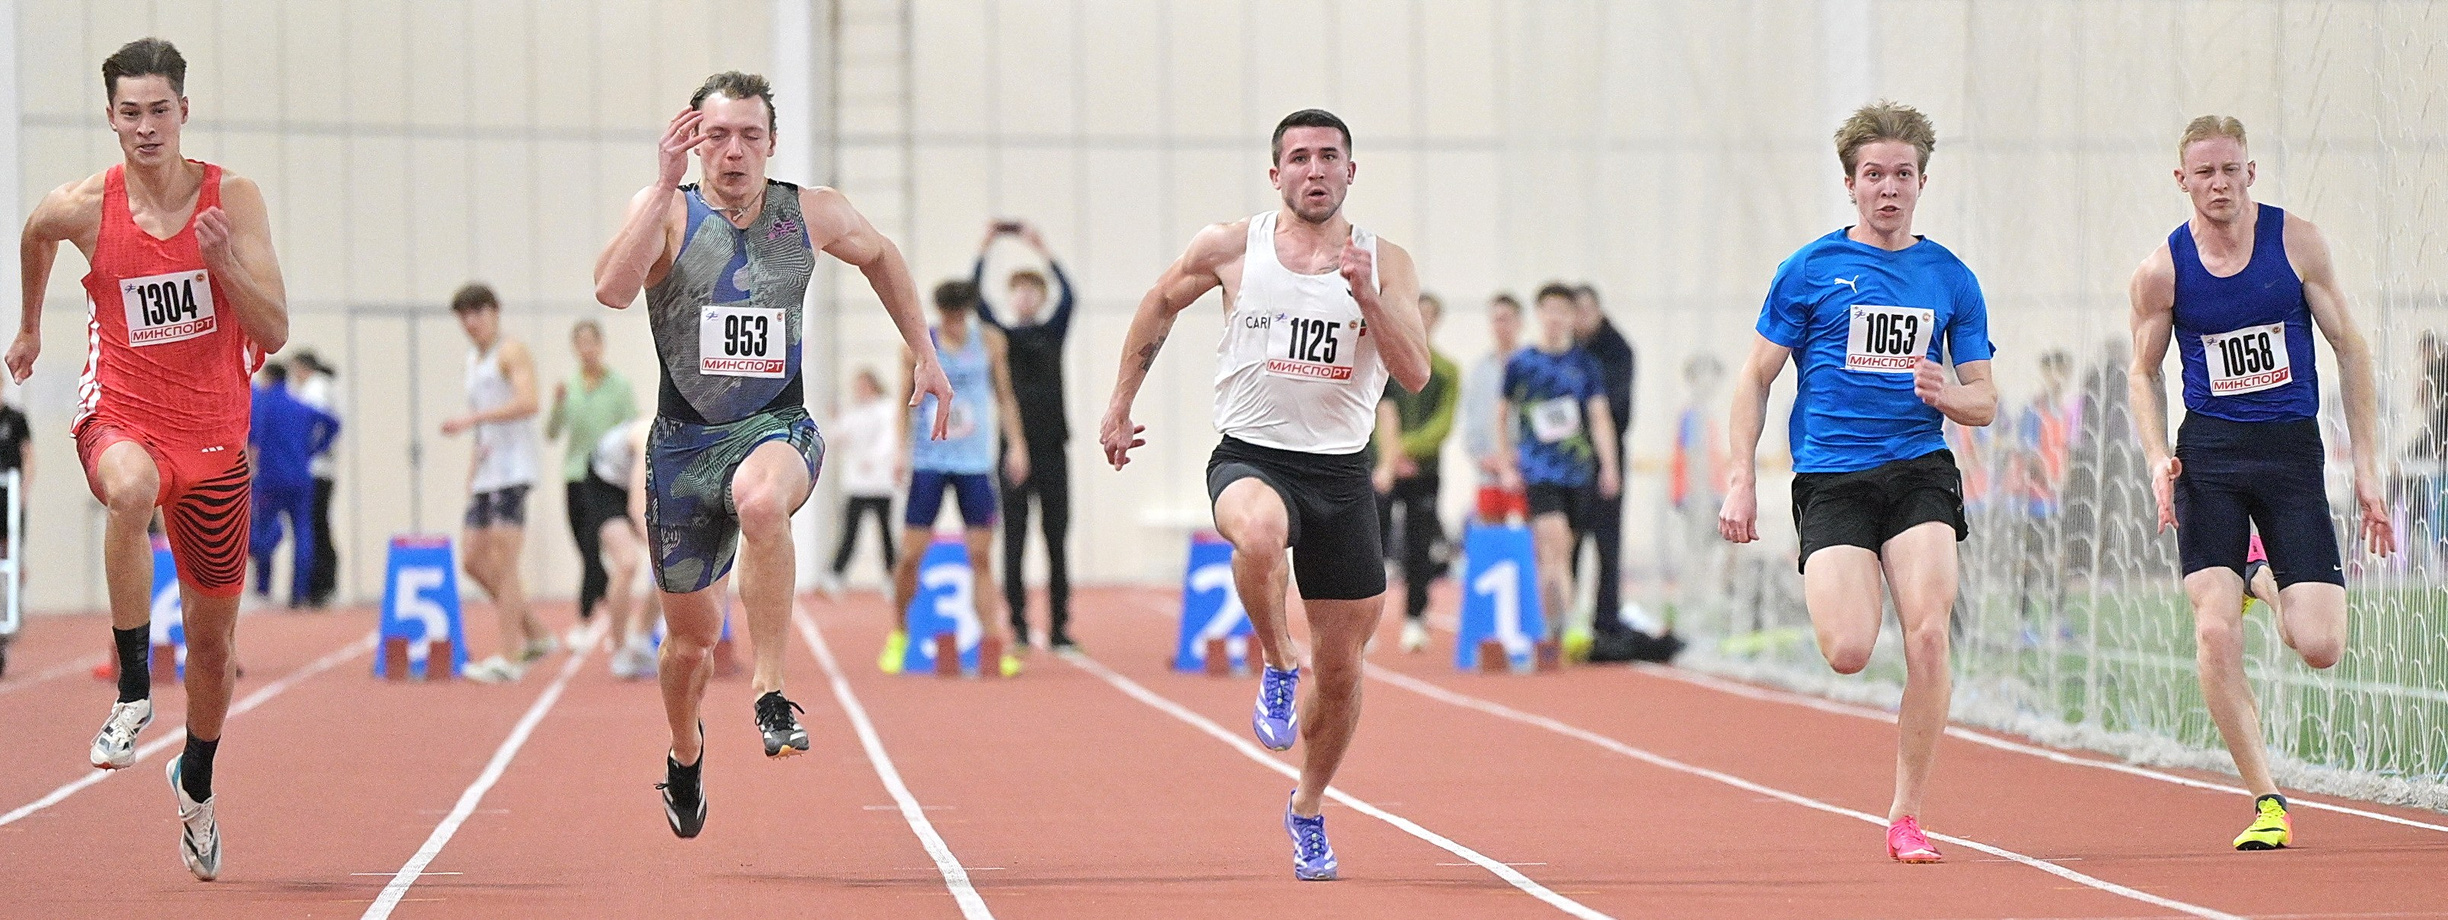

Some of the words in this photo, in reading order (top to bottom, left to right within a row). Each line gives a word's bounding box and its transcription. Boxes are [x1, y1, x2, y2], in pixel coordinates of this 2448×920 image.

[137, 279, 198, 326] 1304
[133, 318, 213, 341] МИНСПОРТ
[724, 314, 768, 357] 953
[1288, 317, 1341, 364] 1125
[1866, 313, 1918, 355] 1053
[704, 359, 783, 371] МИНСПОРТ
[1268, 361, 1352, 378] МИНСПОРТ
[1849, 356, 1916, 369] МИНСПОР
[2218, 331, 2275, 377] 1058
[2213, 368, 2287, 391] МИНСПОРТ
[395, 567, 450, 662] 5
[920, 563, 983, 659] 3
[1190, 562, 1250, 660] 2
[1474, 561, 1533, 656] 1
